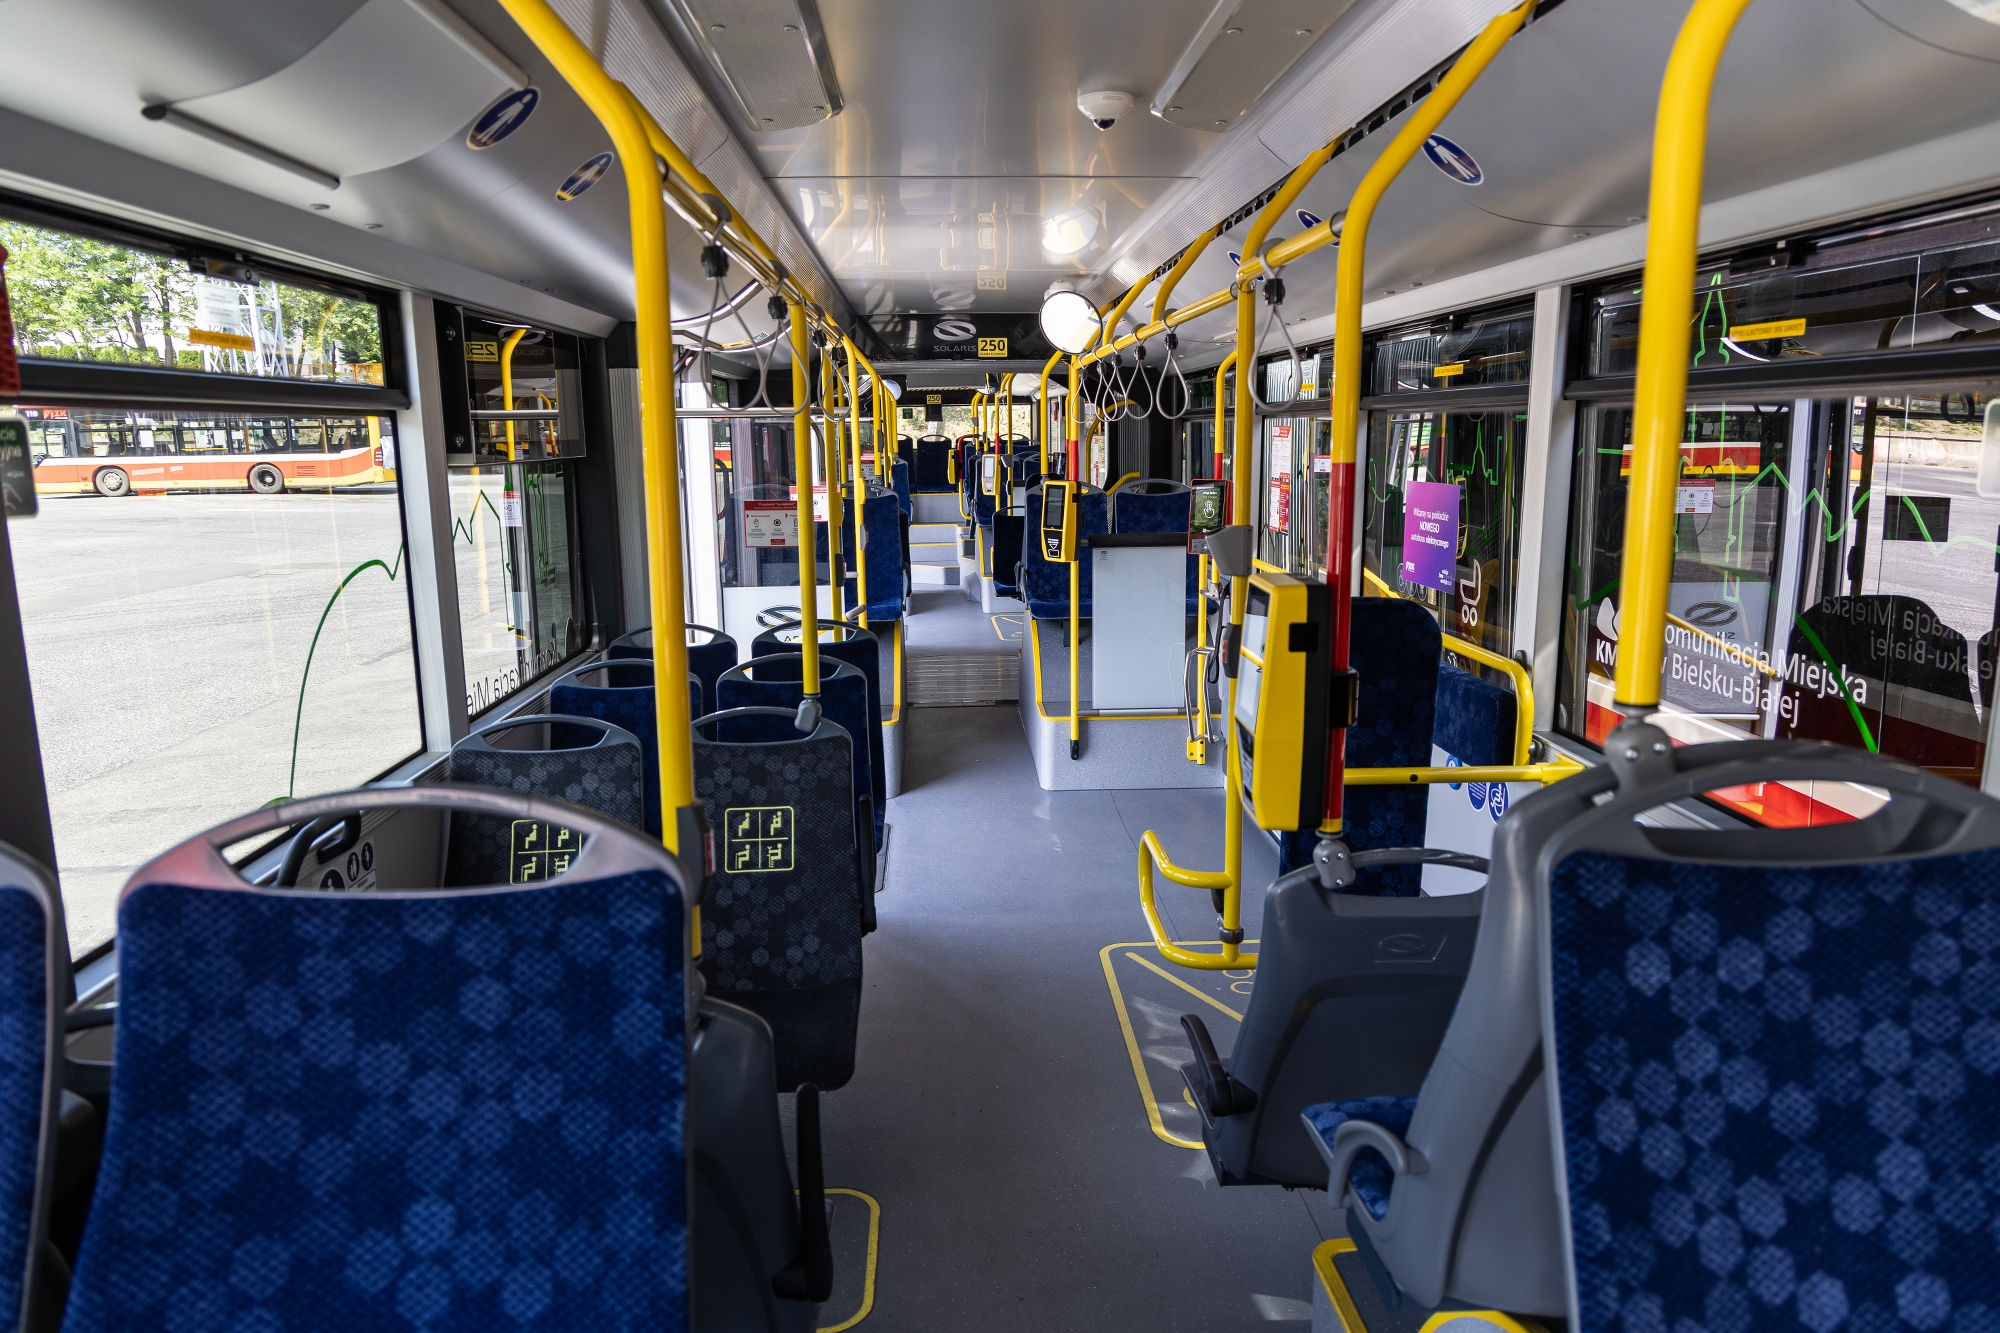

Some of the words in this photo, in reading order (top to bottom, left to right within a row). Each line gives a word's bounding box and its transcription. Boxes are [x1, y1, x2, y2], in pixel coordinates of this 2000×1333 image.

[980, 339, 1005, 351] 250
[42, 409, 67, 419] MZK
[1420, 520, 1440, 533] NOWEGO
[1664, 623, 1769, 677] omunikacja
[1778, 649, 1867, 704] Miejska
[1672, 653, 1800, 728] Bielsku-Białej
